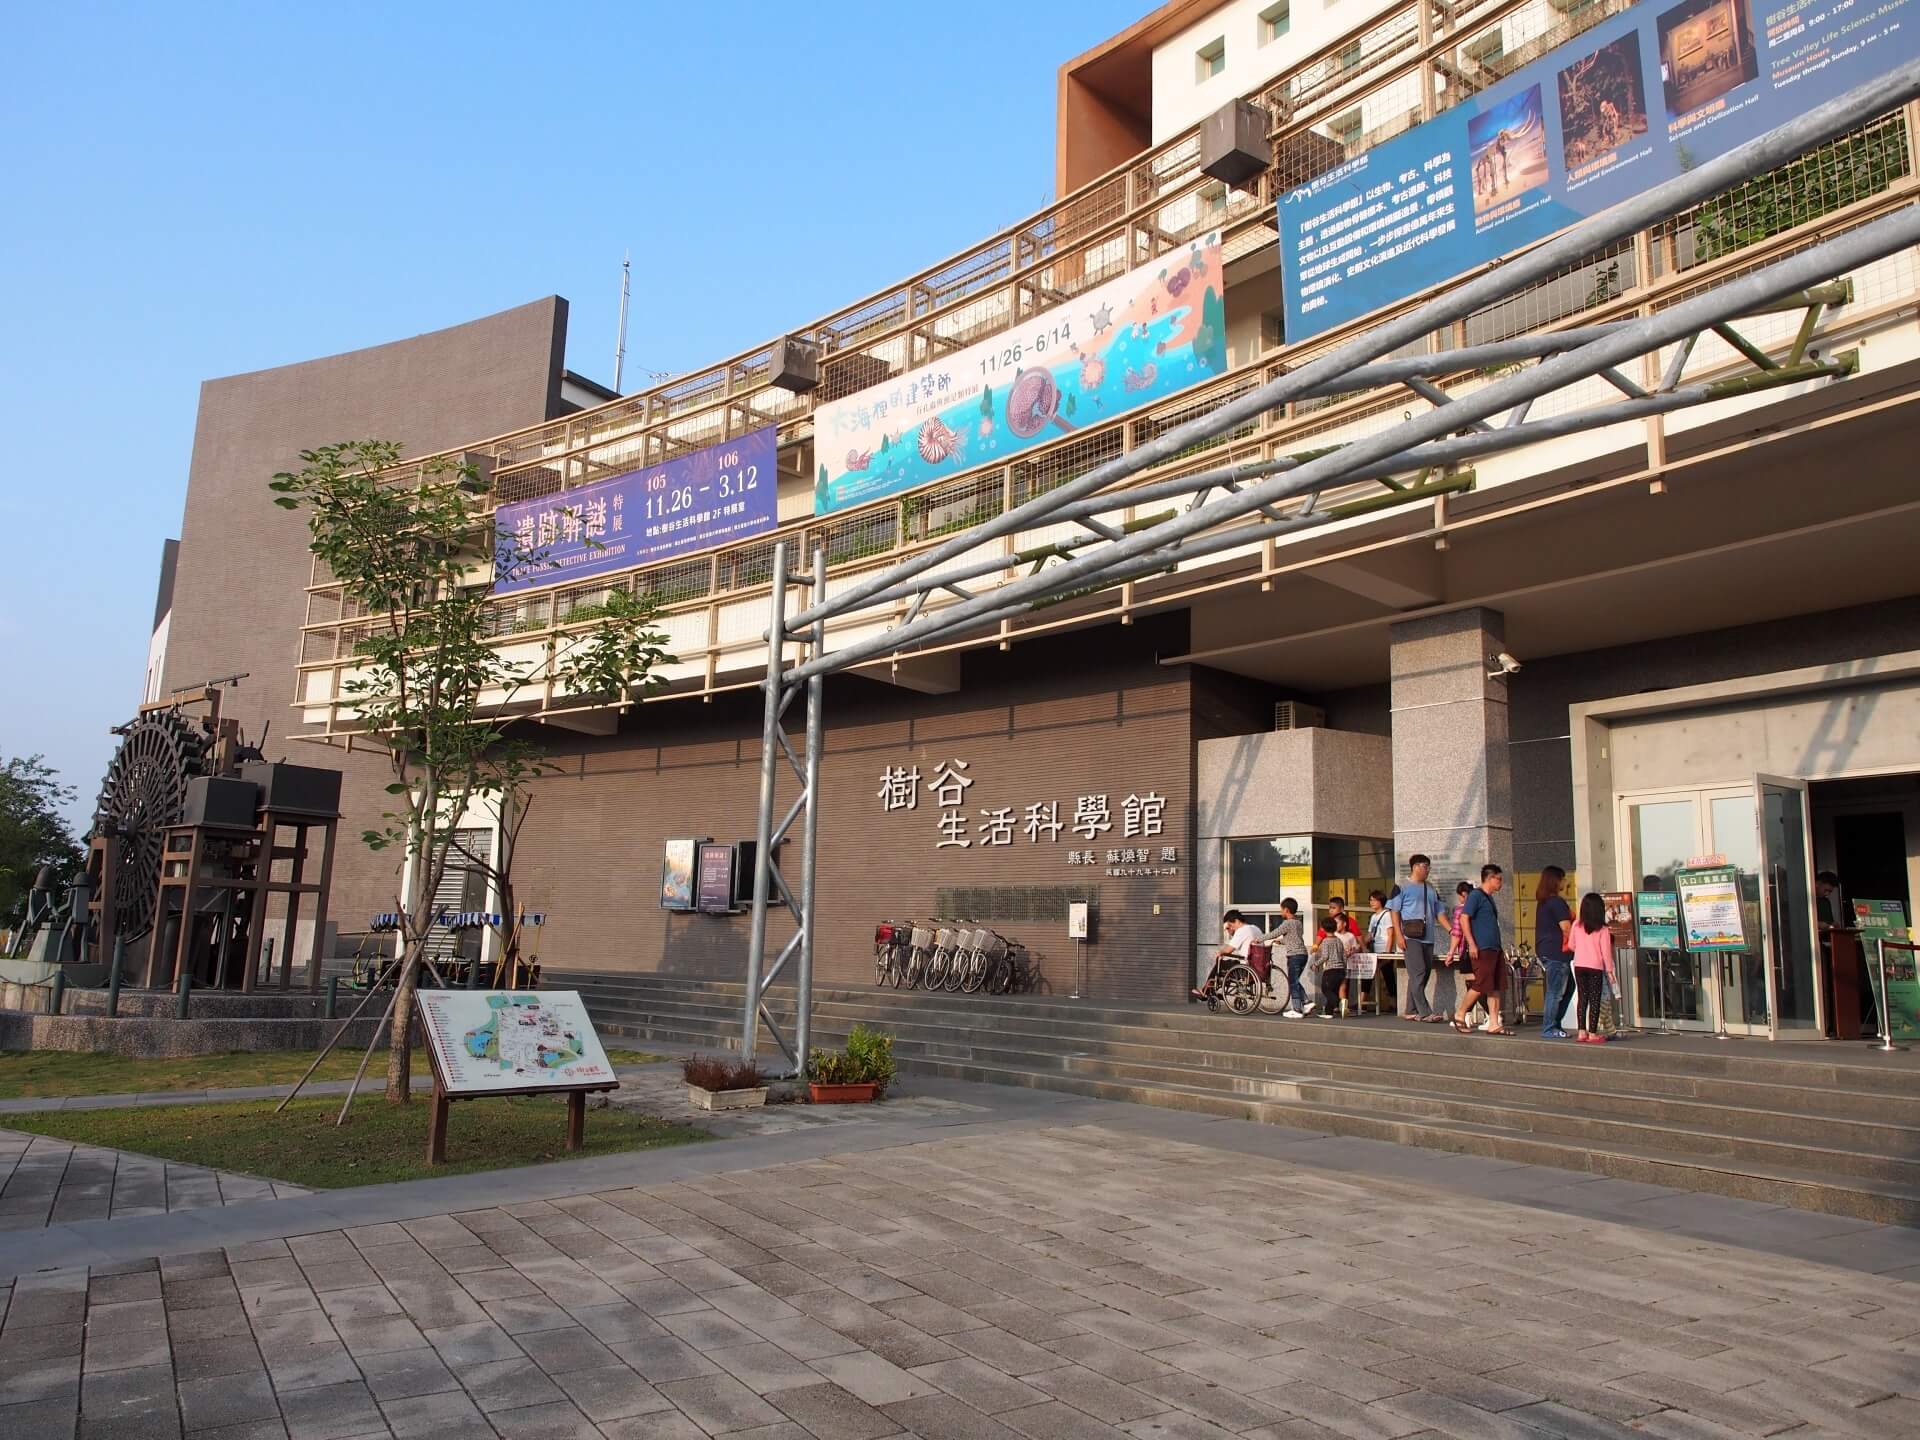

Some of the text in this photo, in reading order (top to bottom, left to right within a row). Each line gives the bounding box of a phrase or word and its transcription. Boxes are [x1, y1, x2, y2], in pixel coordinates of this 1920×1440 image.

[1809, 14, 1825, 26] 9:00
[1832, 0, 1854, 14] 17:00
[1771, 56, 1791, 69] Tree
[1792, 41, 1820, 58] Valley
[1822, 32, 1839, 44] Life
[1841, 13, 1876, 34] Science
[1774, 73, 1800, 89] Tuesday
[1802, 58, 1830, 76] through
[1831, 45, 1859, 62] Sunday,
[1867, 34, 1877, 43] AM
[1890, 23, 1900, 32] PM
[1772, 48, 1830, 80] Museum Hours
[1668, 93, 1759, 143] Science and Civilization Hall
[1567, 179, 1588, 192] Human
[1589, 171, 1600, 182] and
[1640, 147, 1653, 158] Hall
[1494, 217, 1505, 226] and
[1540, 195, 1552, 206] Hall
[719, 451, 738, 470] 106
[646, 487, 692, 519] 11.26
[719, 466, 757, 498] 3.12
[648, 474, 666, 492] 105
[713, 508, 722, 520] 2F
[590, 544, 626, 560] EXHIBITION
[877, 758, 974, 812] 樹谷
[936, 791, 1168, 848] 生活科學館
[1068, 850, 1096, 865] 縣長
[1160, 847, 1176, 861] 題
